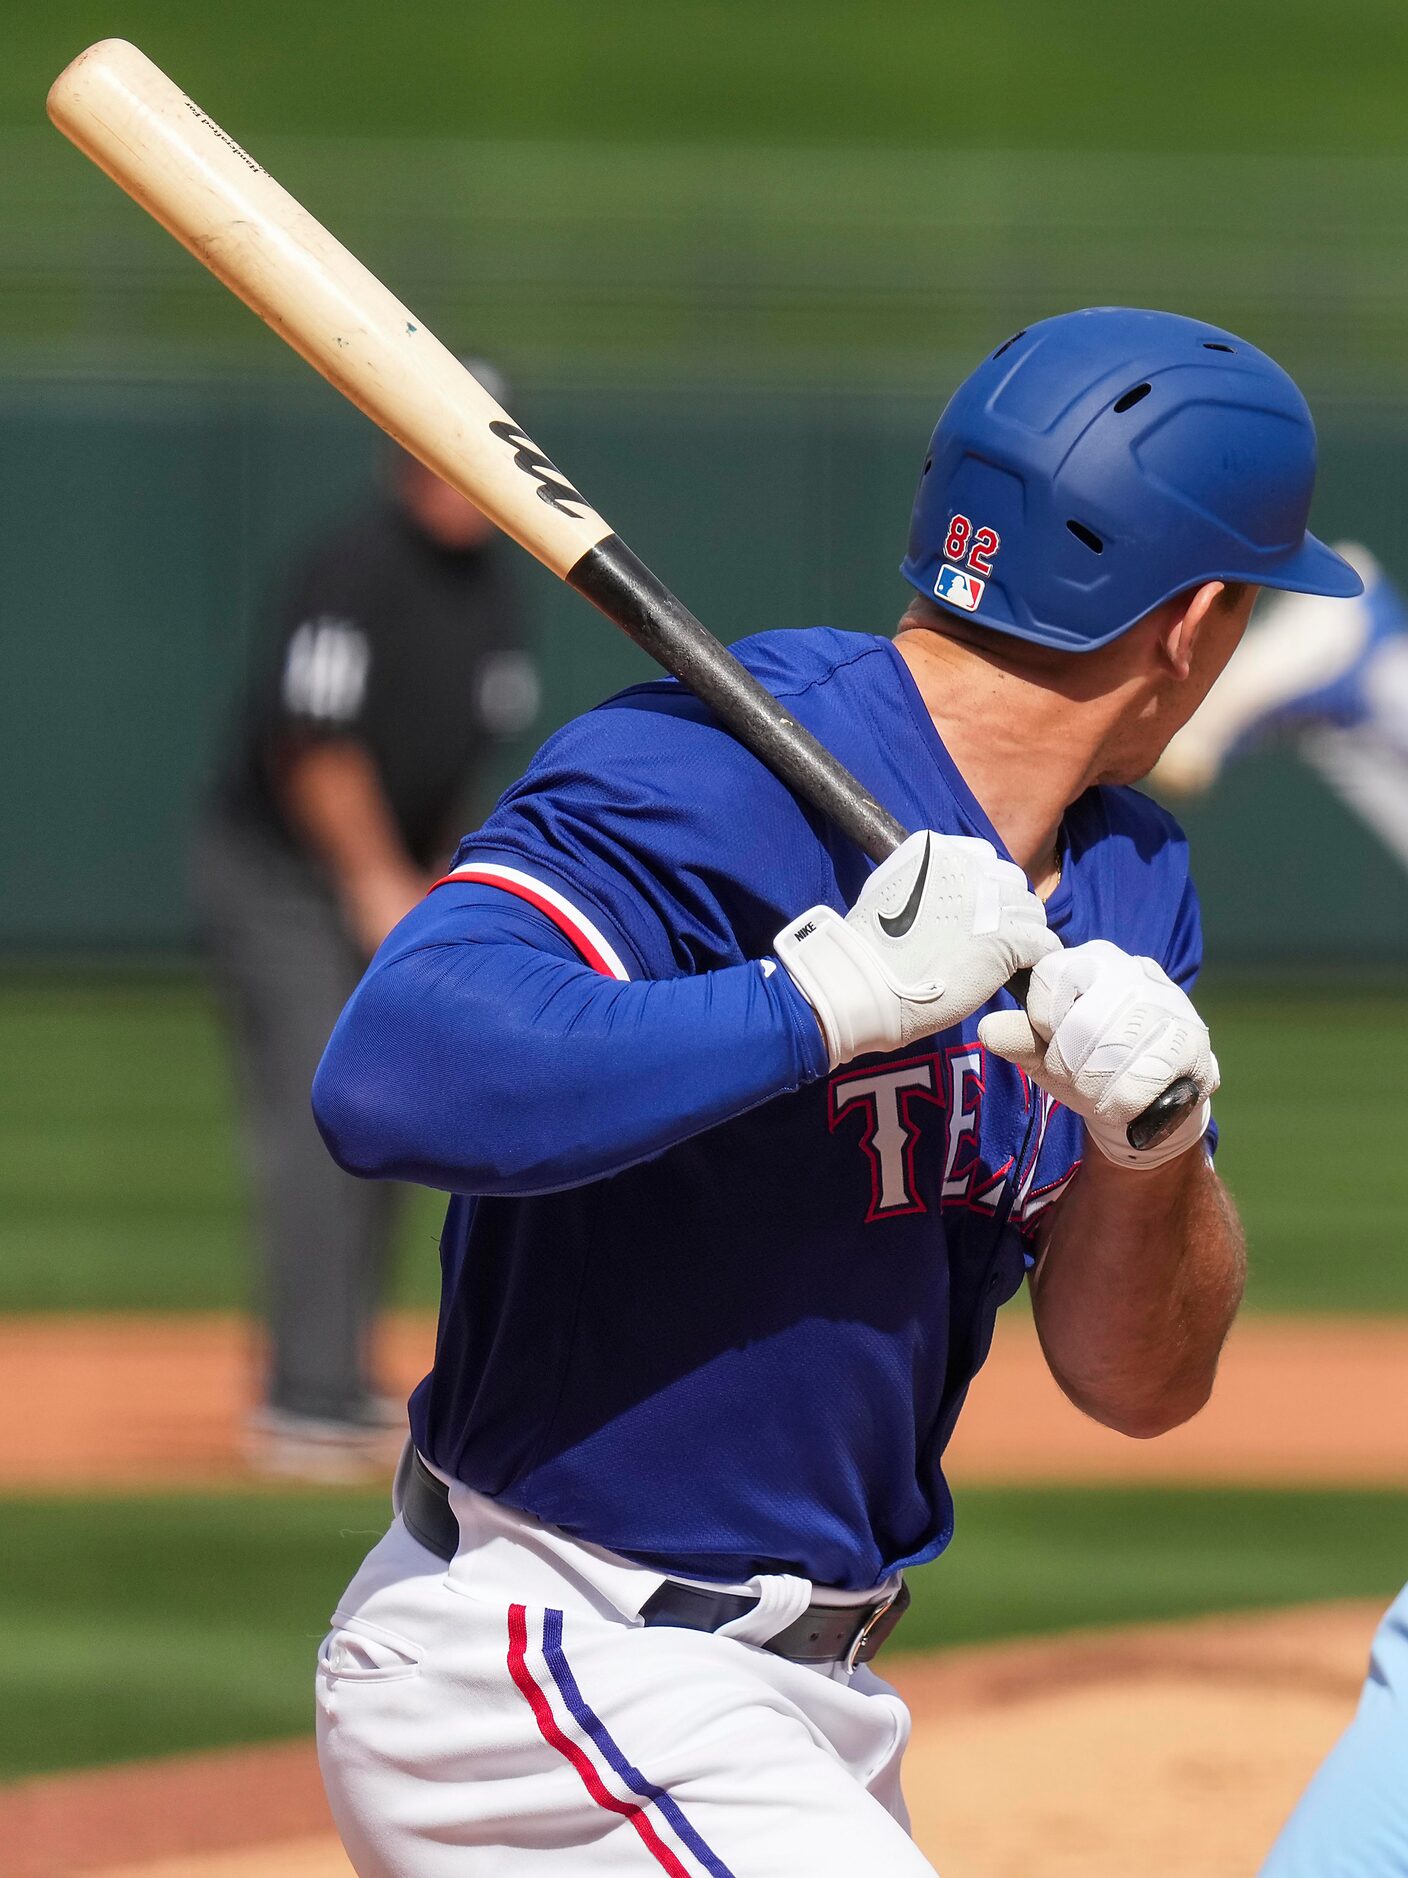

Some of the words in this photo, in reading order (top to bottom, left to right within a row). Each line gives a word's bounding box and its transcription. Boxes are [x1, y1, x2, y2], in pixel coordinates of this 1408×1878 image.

[184, 101, 202, 117] For
[201, 118, 259, 173] Handcrafted
[943, 514, 1000, 578] 82
[794, 921, 817, 942] NIKE
